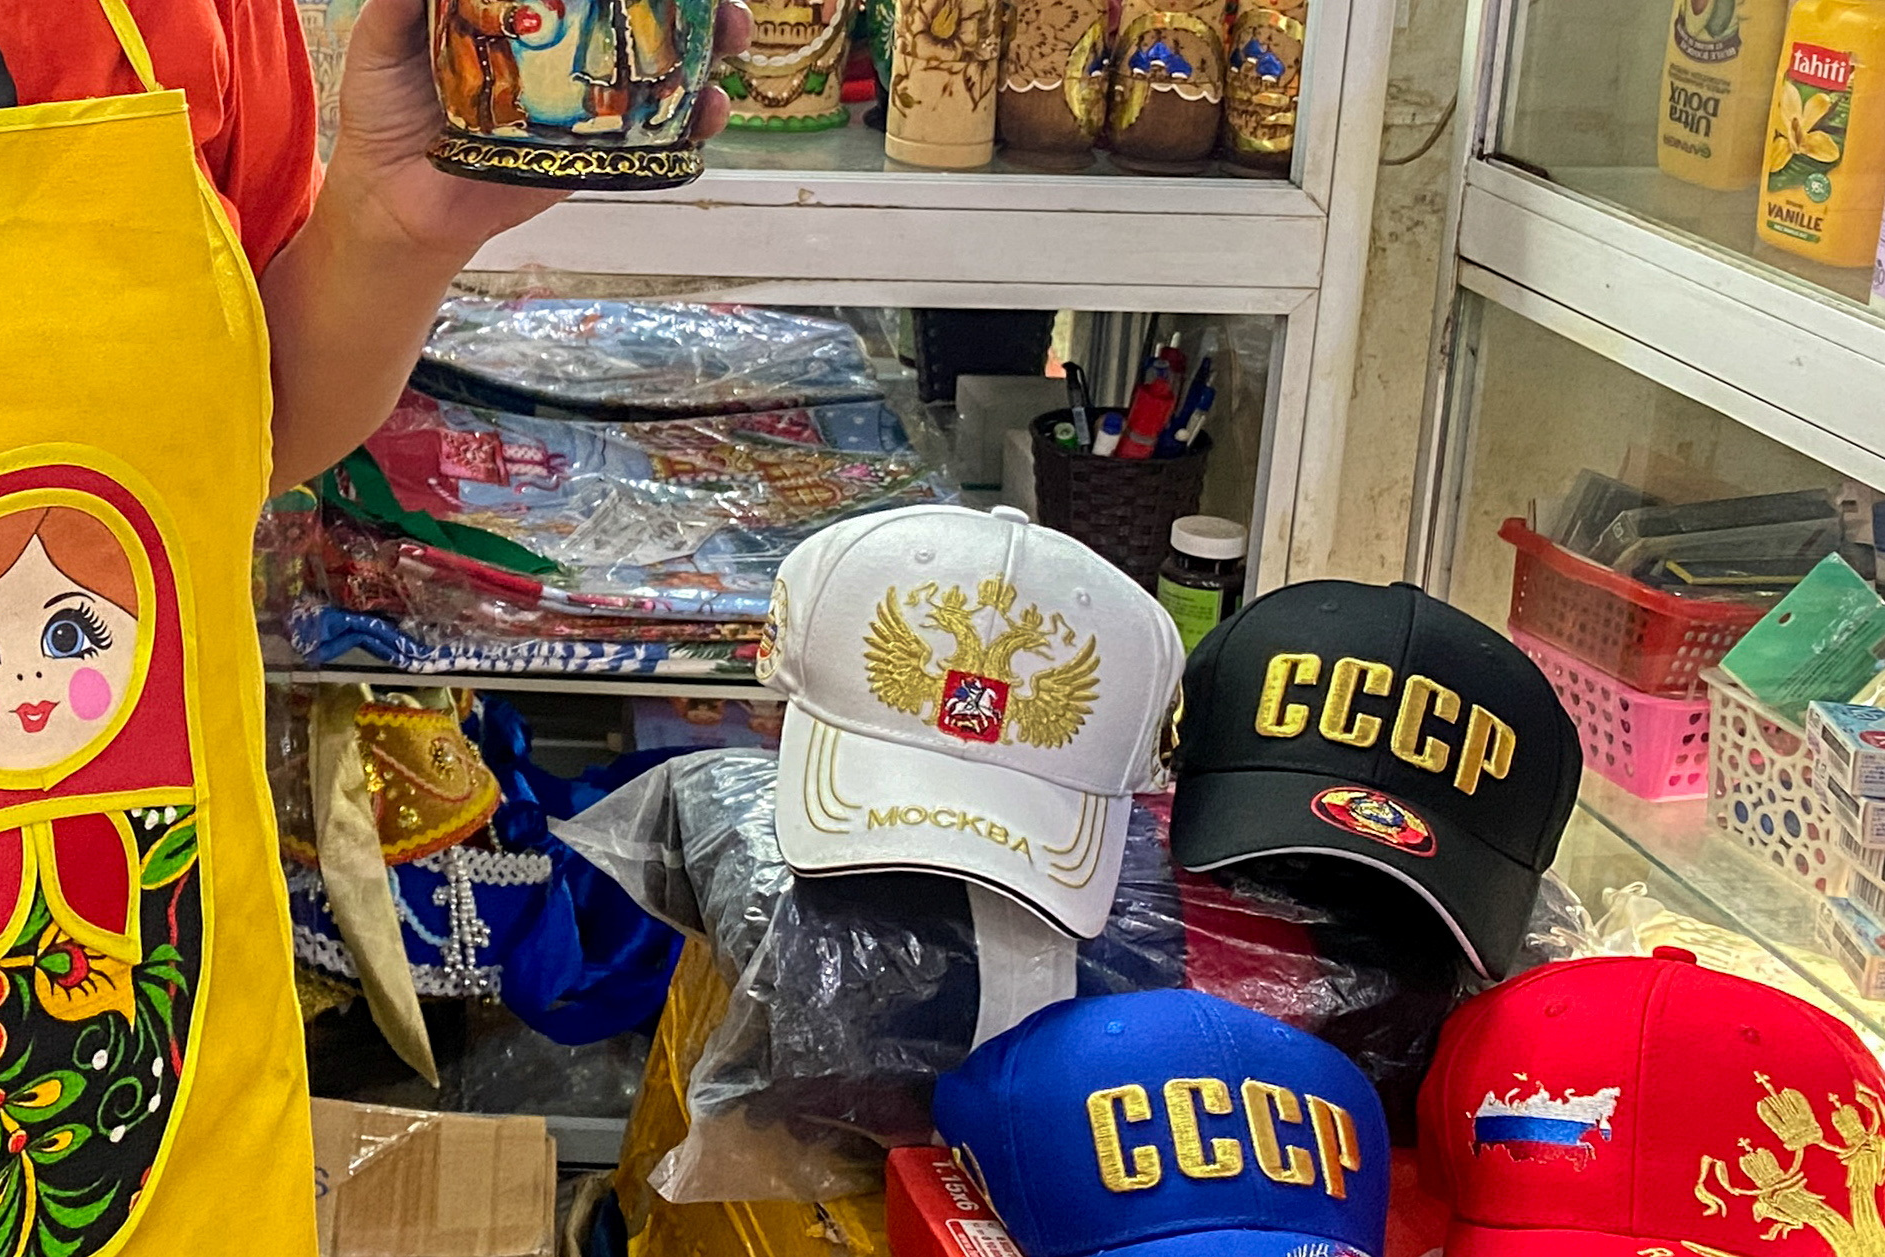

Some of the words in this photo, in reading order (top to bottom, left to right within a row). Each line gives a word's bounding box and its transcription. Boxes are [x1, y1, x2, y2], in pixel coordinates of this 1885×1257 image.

[1793, 48, 1848, 84] tahiti
[1669, 81, 1721, 118] DOUX
[1669, 103, 1712, 138] Ultra
[1767, 201, 1824, 233] VANILLE
[1255, 653, 1516, 795] СССР
[867, 805, 1034, 866] МОСКВА
[1086, 1077, 1361, 1199] СССР
